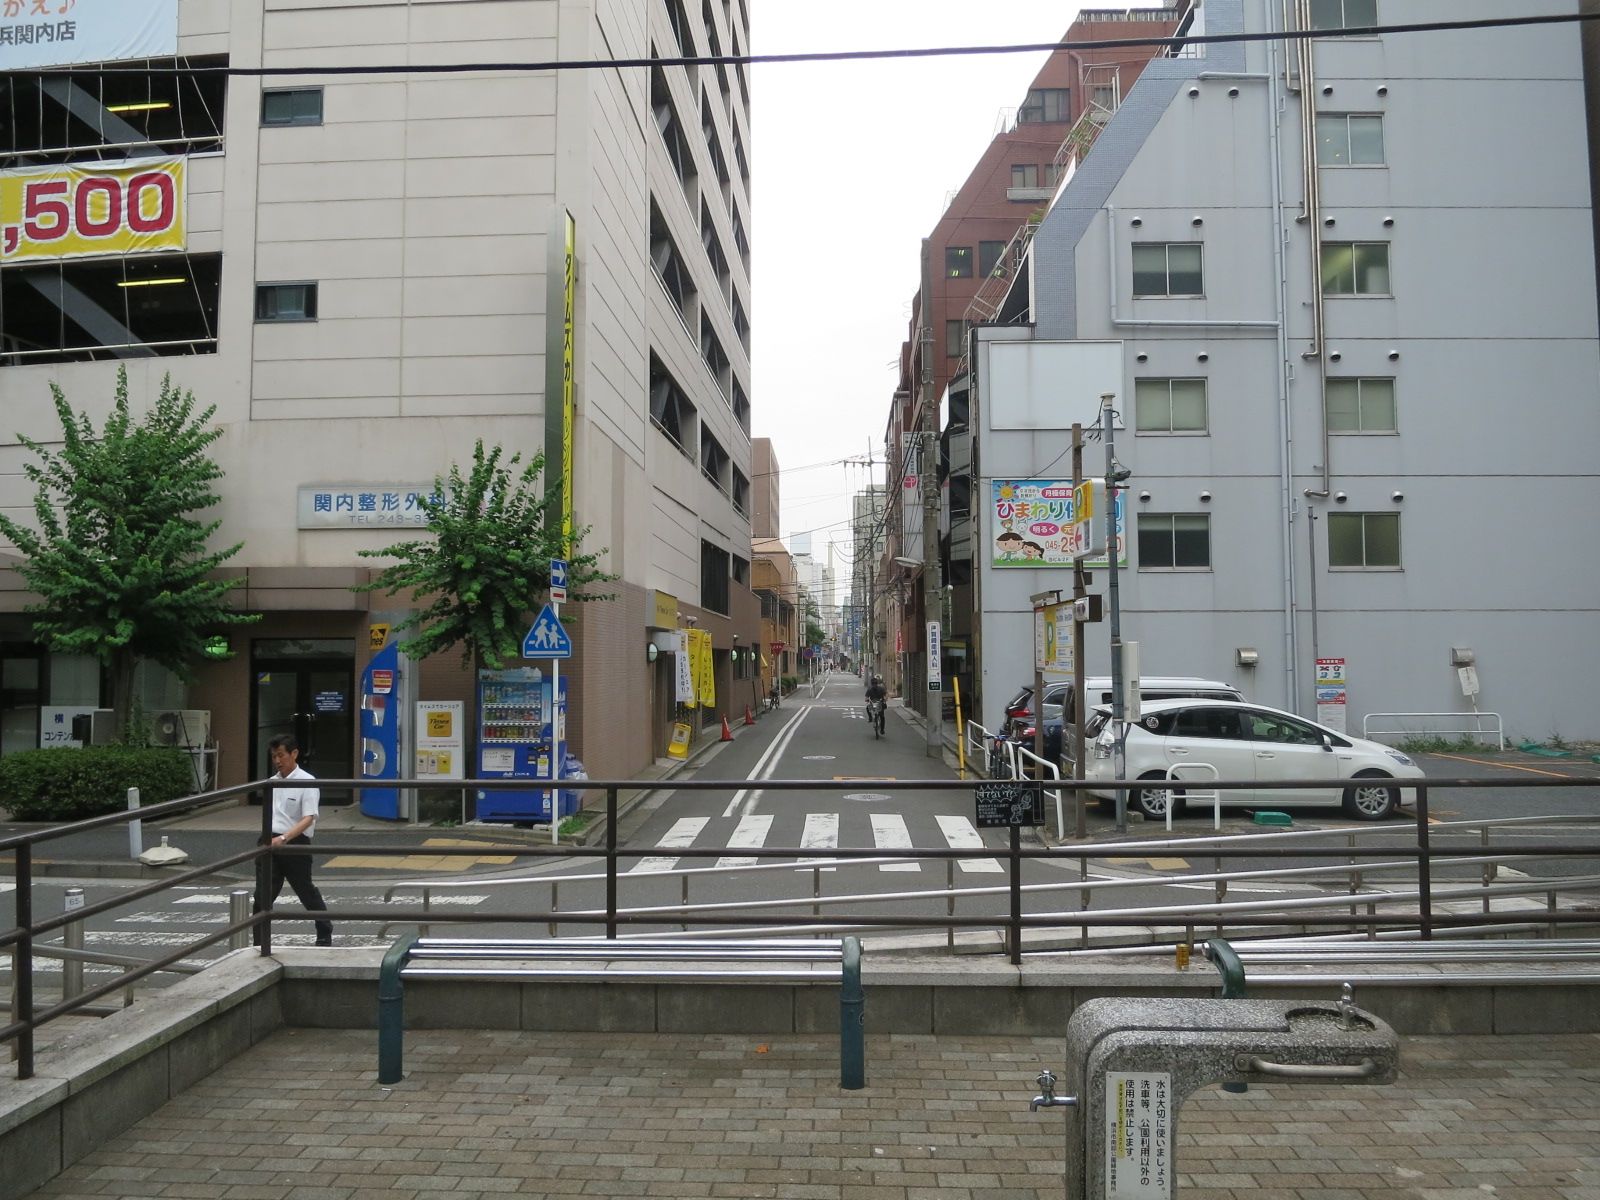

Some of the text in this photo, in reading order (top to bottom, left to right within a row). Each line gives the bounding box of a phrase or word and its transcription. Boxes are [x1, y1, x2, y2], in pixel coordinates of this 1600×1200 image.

[1032, 525, 1055, 534] 明るく
[1125, 1079, 1135, 1162] 使用は禁止します。
[1140, 1079, 1151, 1186] 洗車等、公園利用以外の
[1156, 1079, 1166, 1191] 水は大切に使いましょう。
